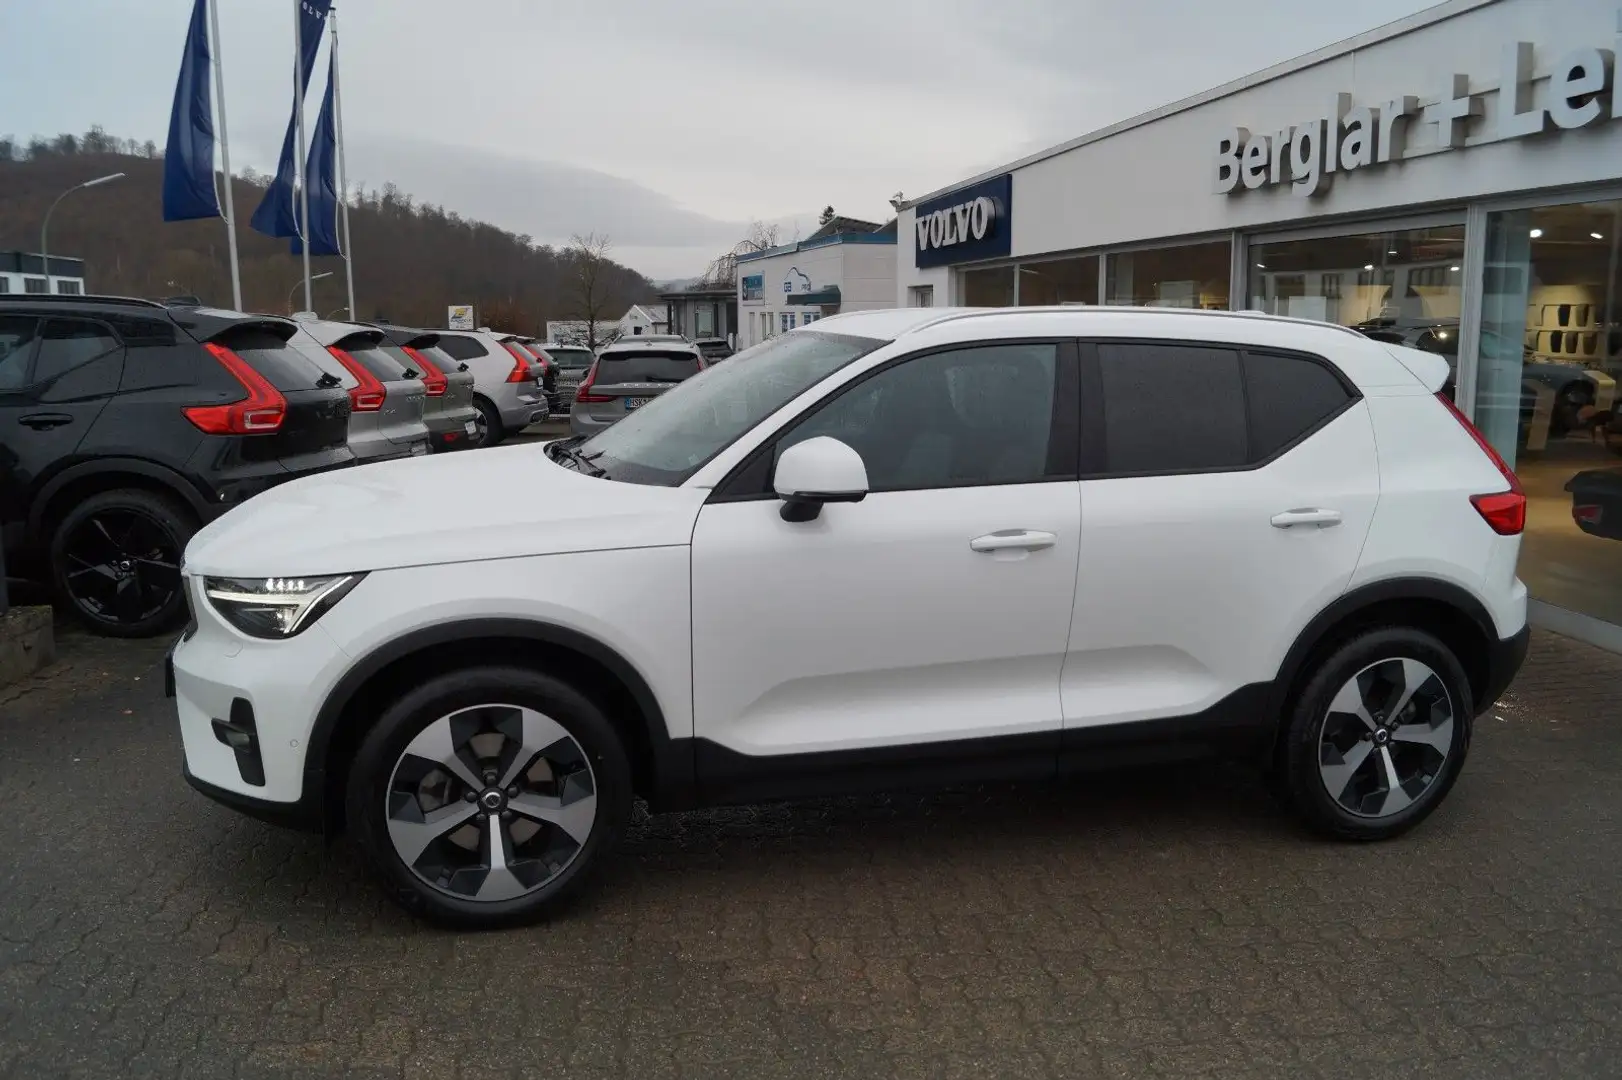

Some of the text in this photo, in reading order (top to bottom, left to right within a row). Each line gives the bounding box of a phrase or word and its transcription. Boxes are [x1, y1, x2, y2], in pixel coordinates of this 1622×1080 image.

[1213, 92, 1412, 197] Berglar
[1423, 73, 1475, 150] +
[916, 197, 990, 251] VOLVO
